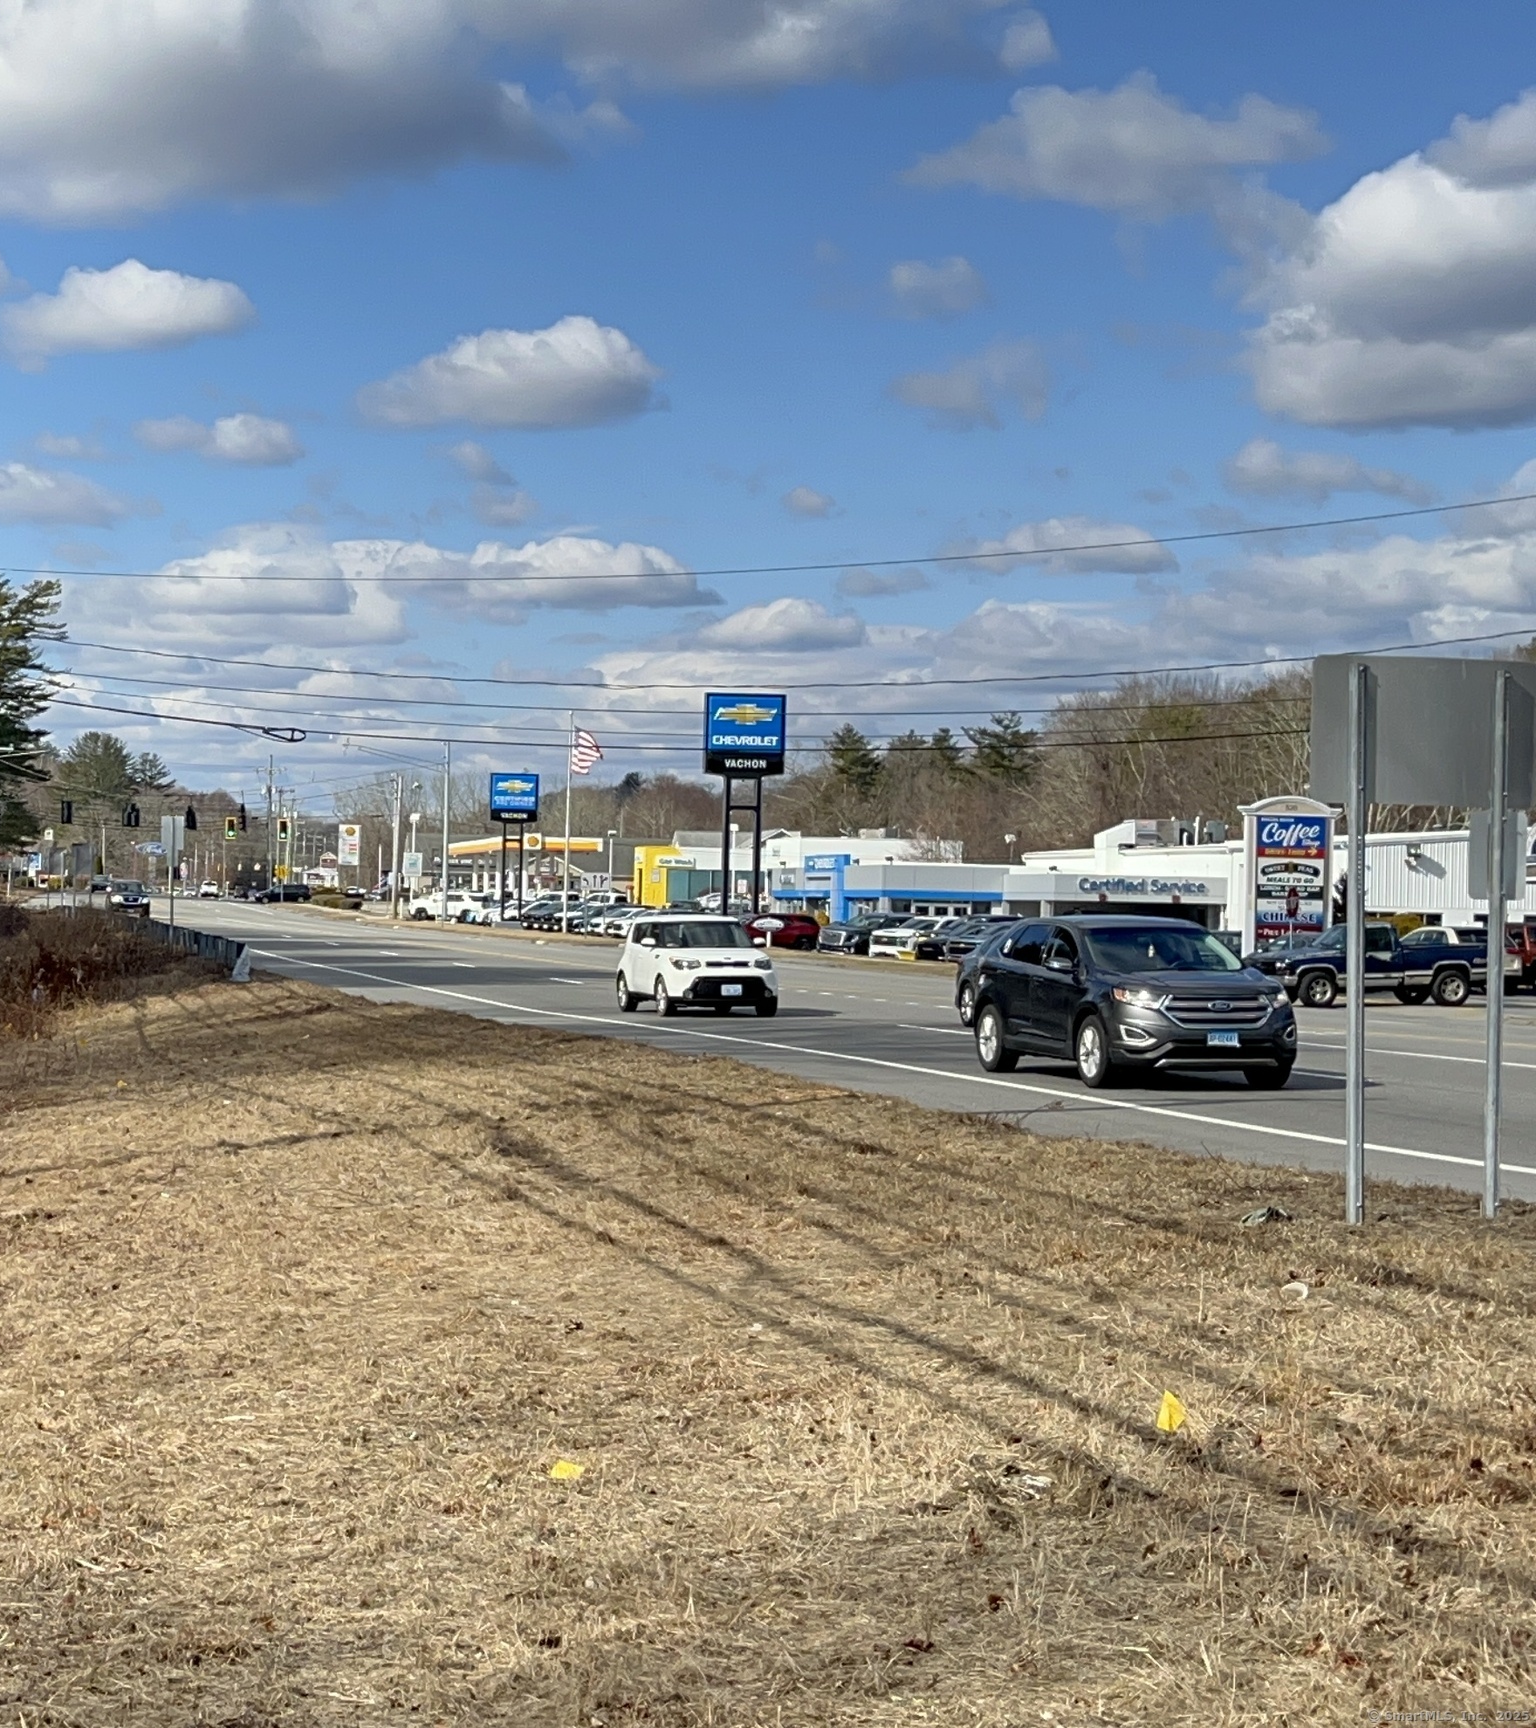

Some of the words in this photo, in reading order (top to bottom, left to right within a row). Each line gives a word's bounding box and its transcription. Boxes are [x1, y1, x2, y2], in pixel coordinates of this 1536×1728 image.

[712, 735, 779, 746] CHEVROLET
[724, 758, 767, 769] VACHON
[1261, 822, 1320, 847] Coffee
[1079, 877, 1147, 892] Certified
[1150, 878, 1208, 893] Service
